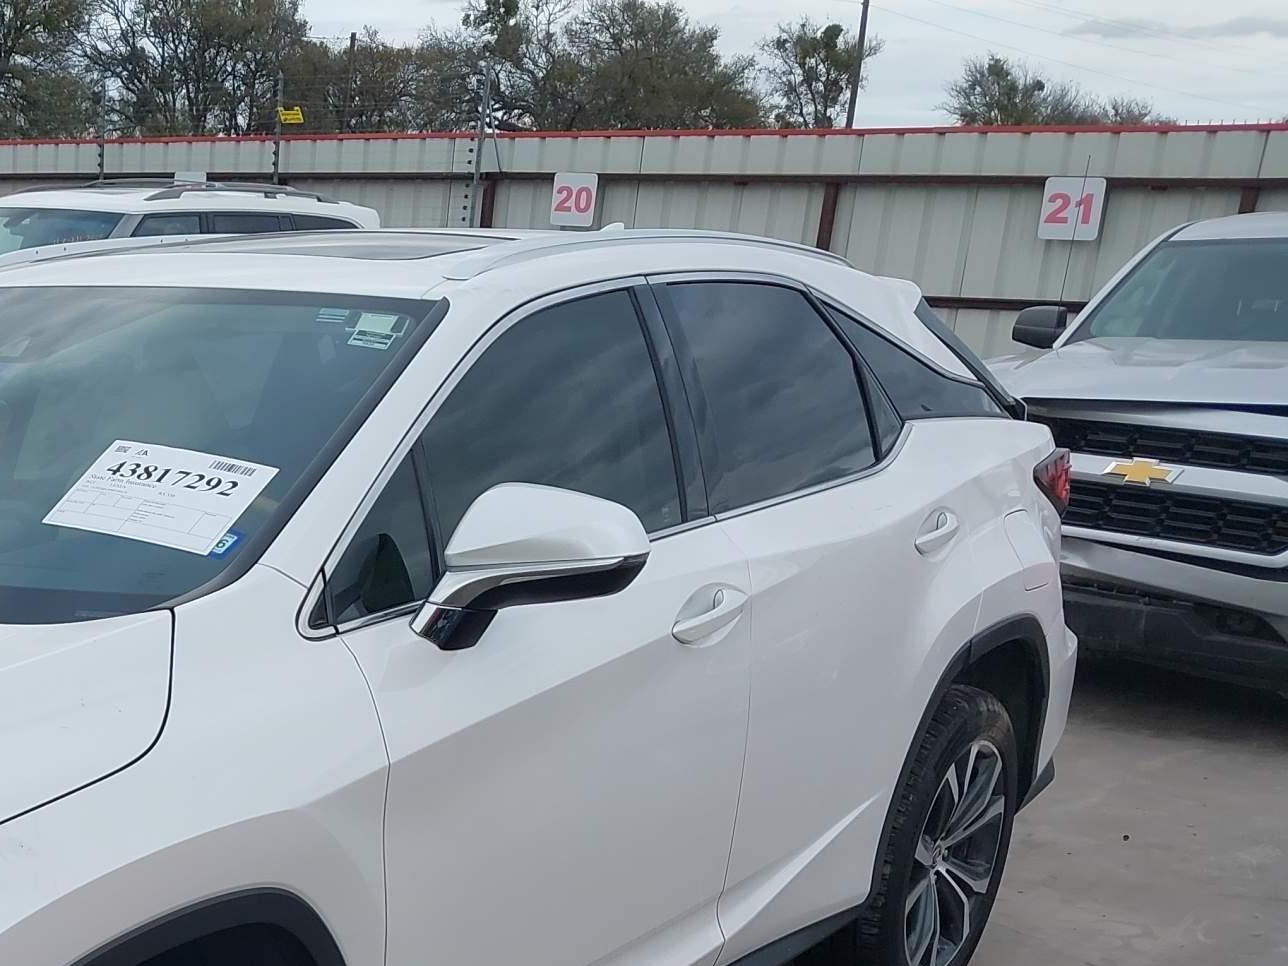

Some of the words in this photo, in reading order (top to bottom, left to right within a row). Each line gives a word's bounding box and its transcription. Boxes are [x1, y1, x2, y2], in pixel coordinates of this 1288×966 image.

[554, 185, 592, 213] 20
[1044, 192, 1094, 224] 21
[106, 459, 240, 497] 43817292
